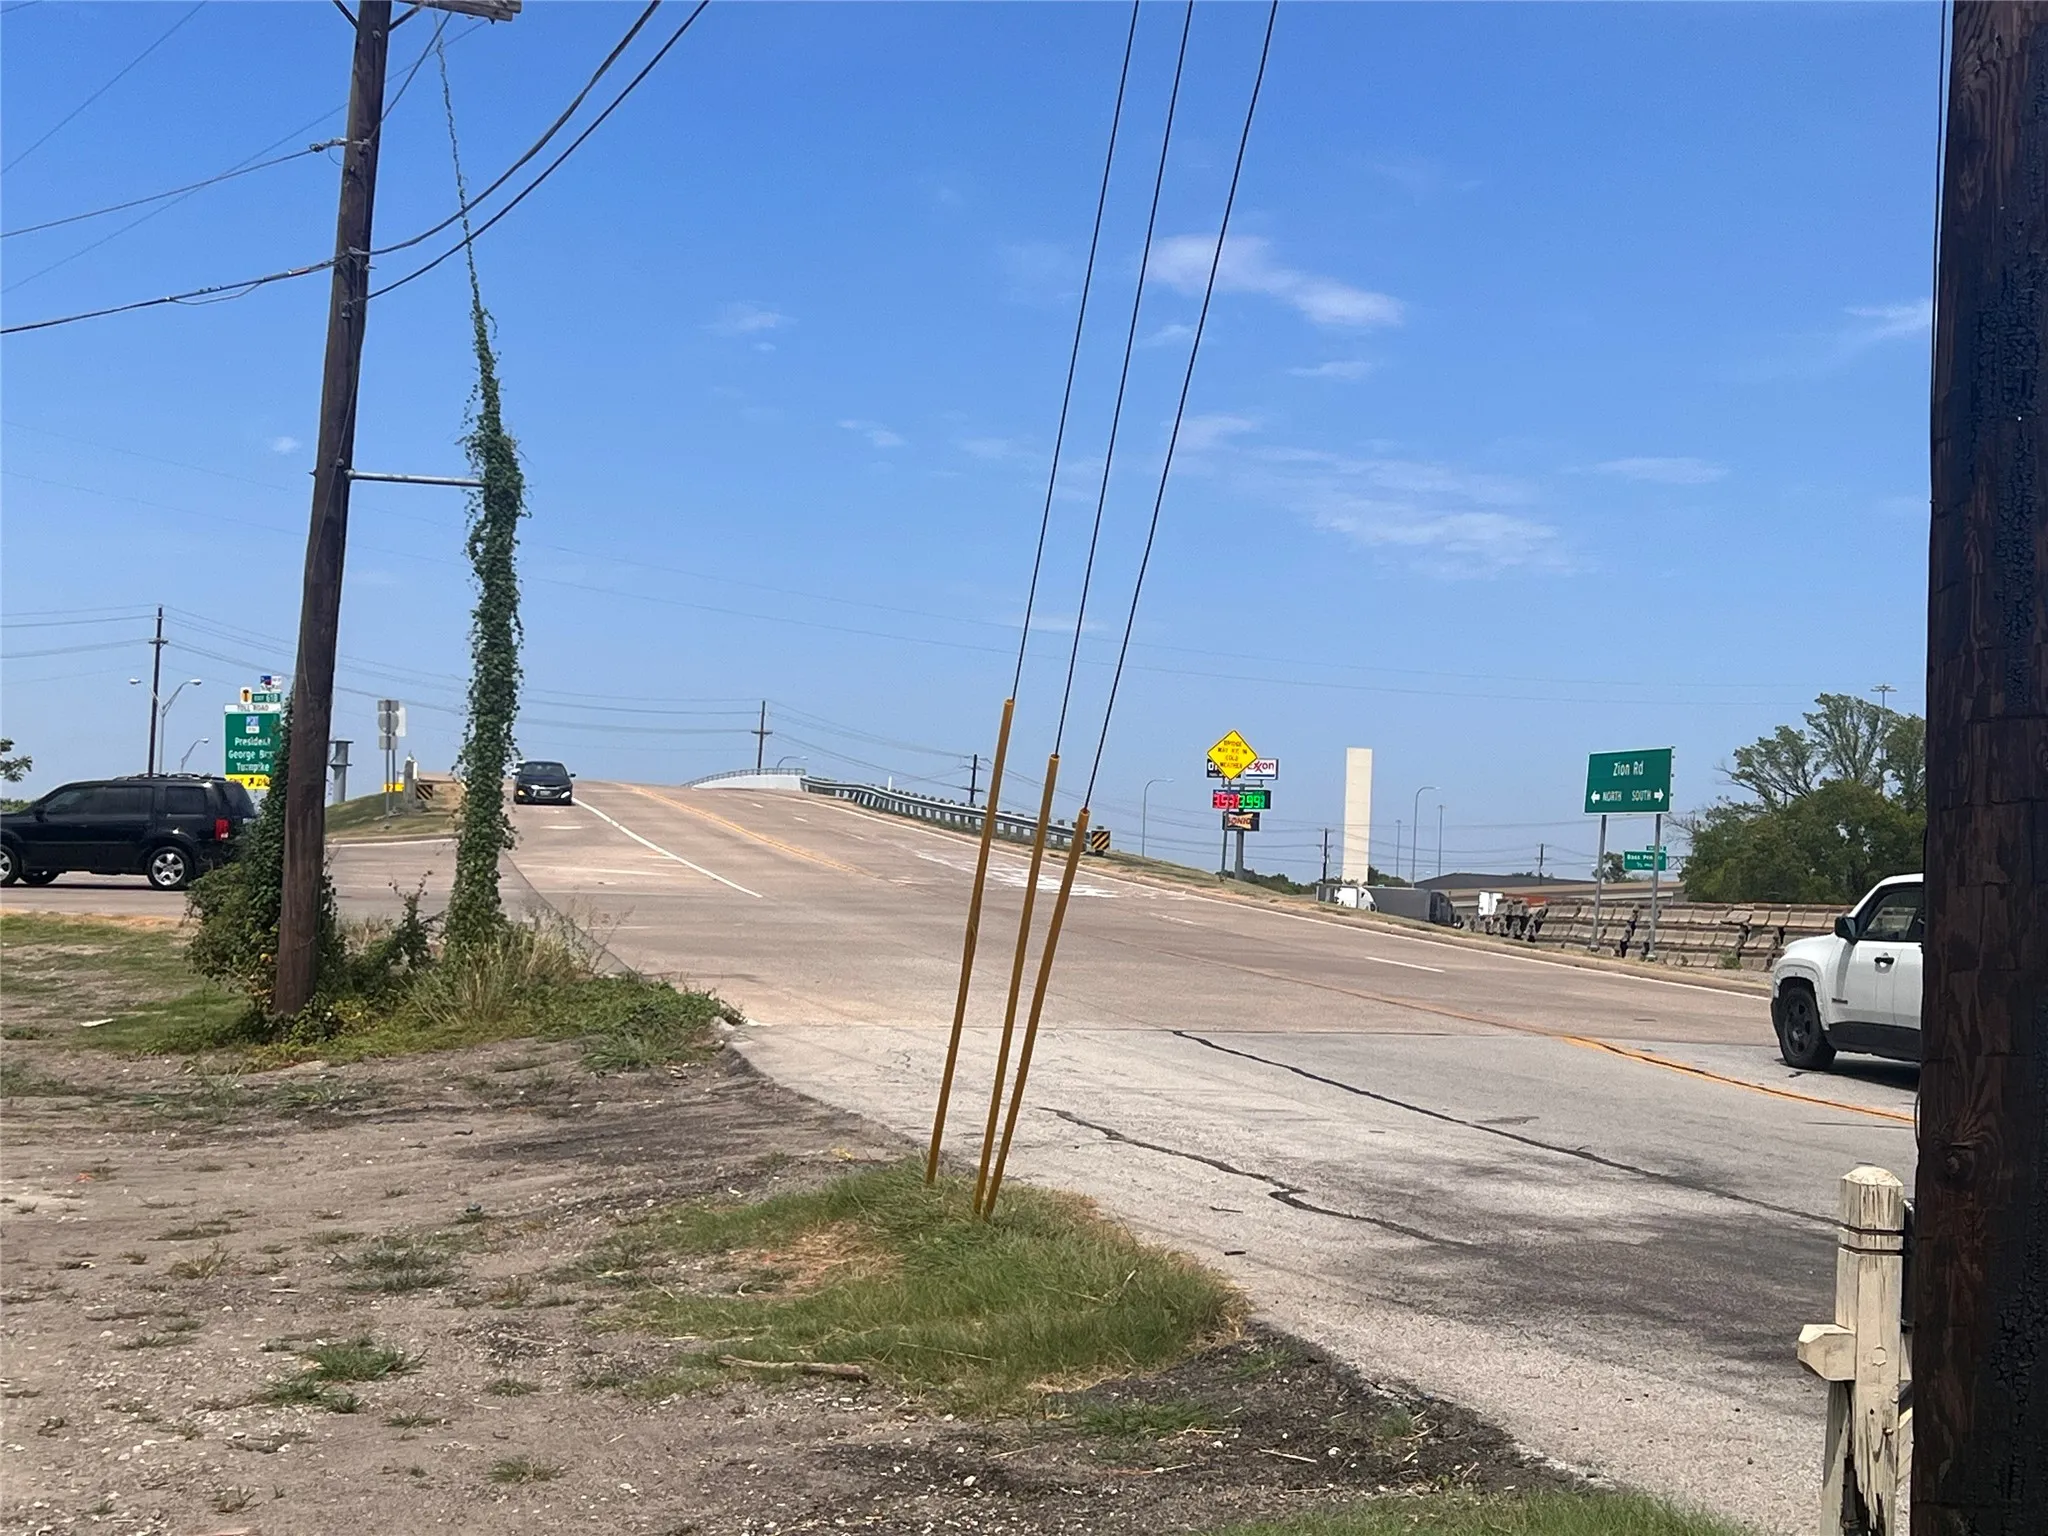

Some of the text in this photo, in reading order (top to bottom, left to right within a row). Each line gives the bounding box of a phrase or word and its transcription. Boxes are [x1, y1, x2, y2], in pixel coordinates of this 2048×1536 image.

[228, 749, 256, 761] George
[236, 762, 270, 774] Turnpike
[1613, 761, 1644, 776] Zion Rd
[1603, 789, 1652, 802] NORTH SOUTH
